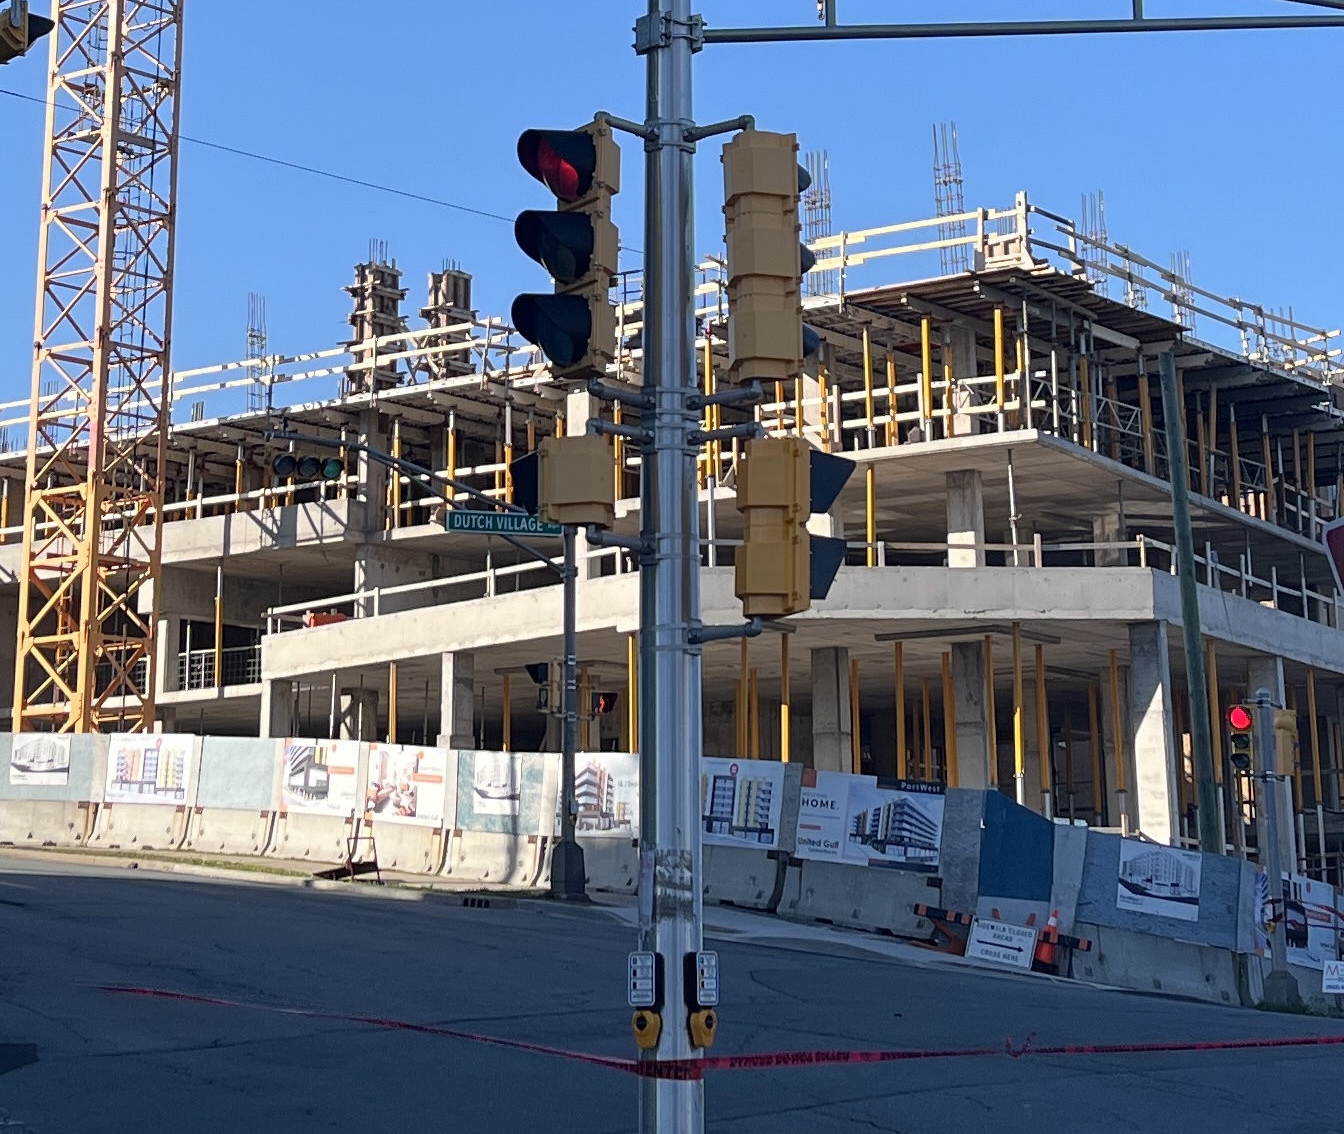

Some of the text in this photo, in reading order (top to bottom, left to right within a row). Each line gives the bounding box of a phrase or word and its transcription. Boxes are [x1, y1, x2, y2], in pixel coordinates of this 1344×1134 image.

[454, 514, 493, 529] DUTCH
[496, 516, 544, 532] VILLAGE
[900, 781, 941, 793] PortWest
